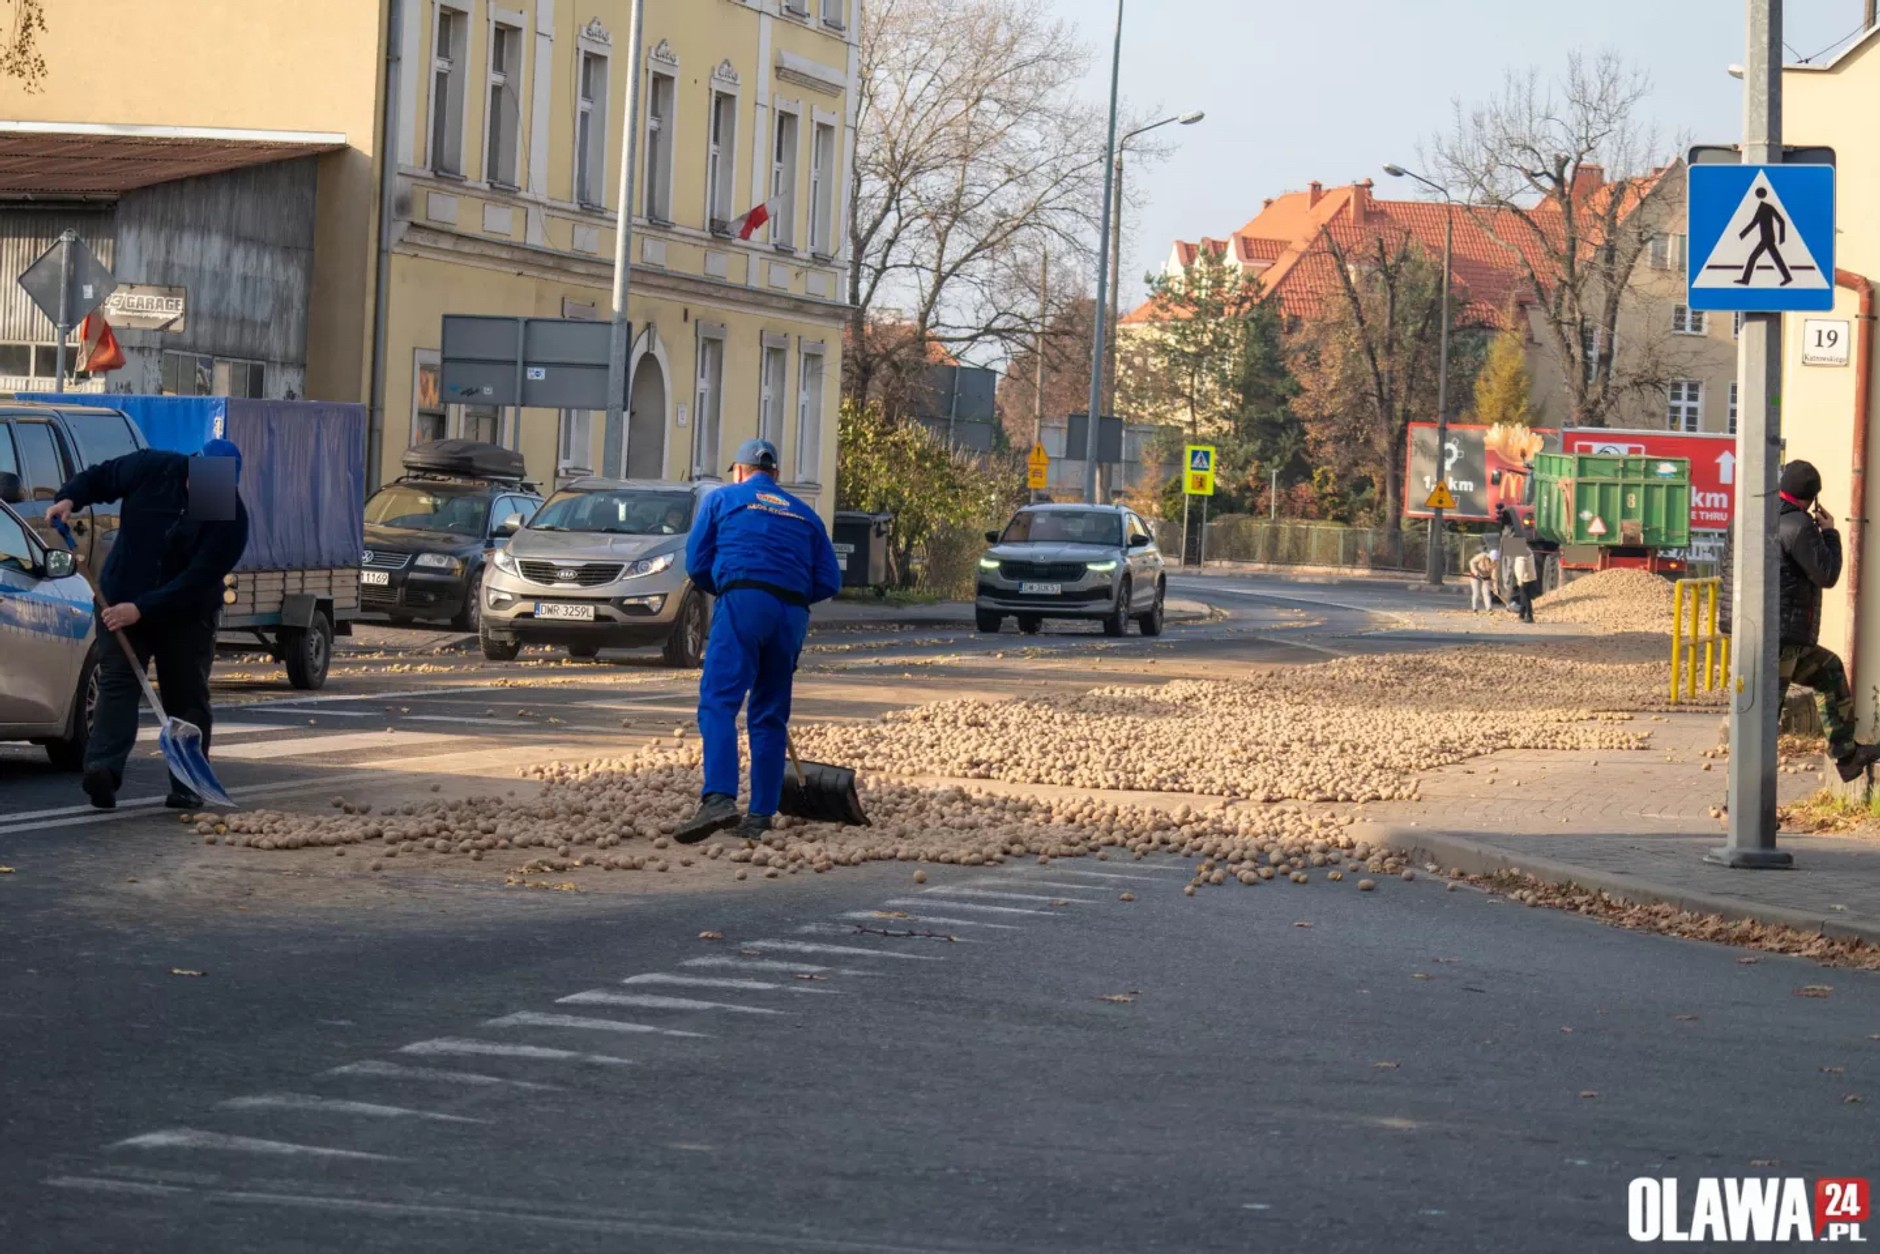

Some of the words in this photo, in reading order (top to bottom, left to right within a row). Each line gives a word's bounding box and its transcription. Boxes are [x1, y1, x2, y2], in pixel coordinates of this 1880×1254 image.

[126, 295, 183, 311] GARAGE
[1814, 329, 1839, 349] 19
[1448, 477, 1474, 493] km
[1691, 486, 1728, 508] km
[1700, 511, 1728, 521] THRU
[541, 604, 560, 616] DWR
[563, 605, 593, 618] 3259L
